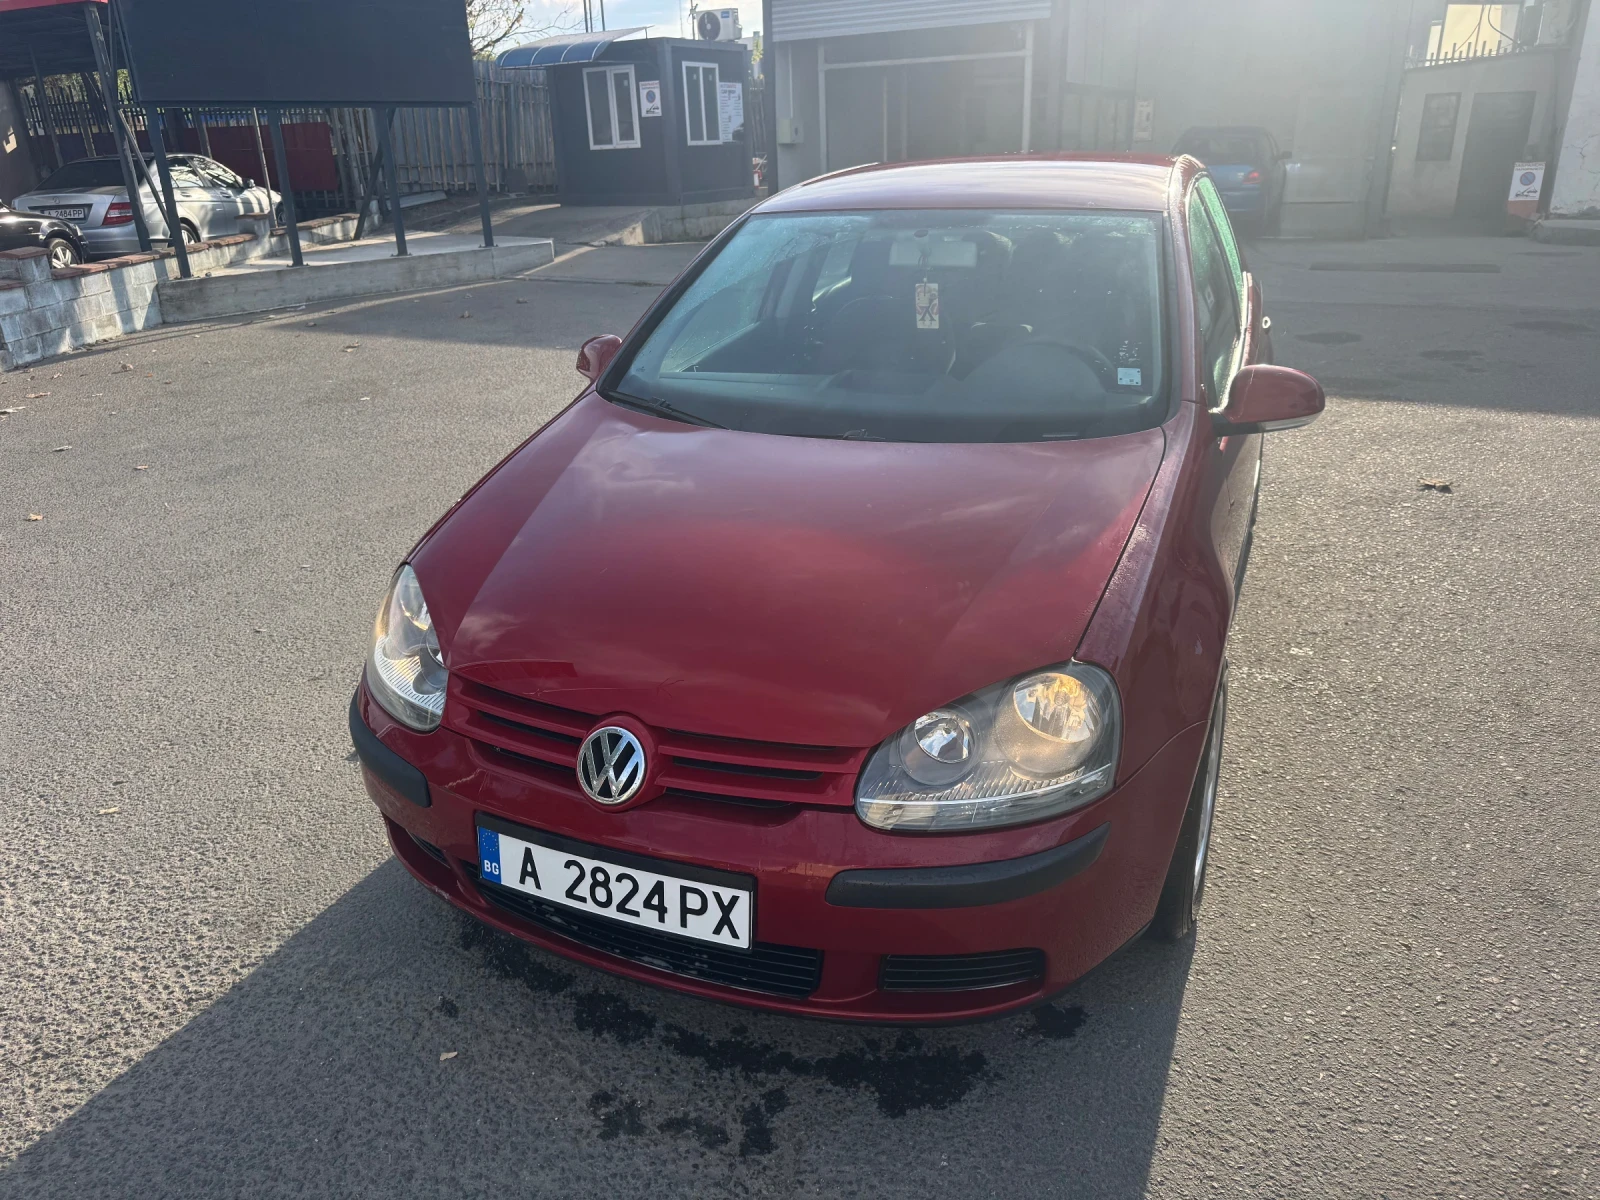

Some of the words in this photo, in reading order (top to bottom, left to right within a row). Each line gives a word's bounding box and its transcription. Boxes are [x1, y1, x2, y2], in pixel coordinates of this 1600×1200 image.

[579, 728, 644, 803] VW
[484, 859, 499, 875] BG
[519, 847, 541, 890] A
